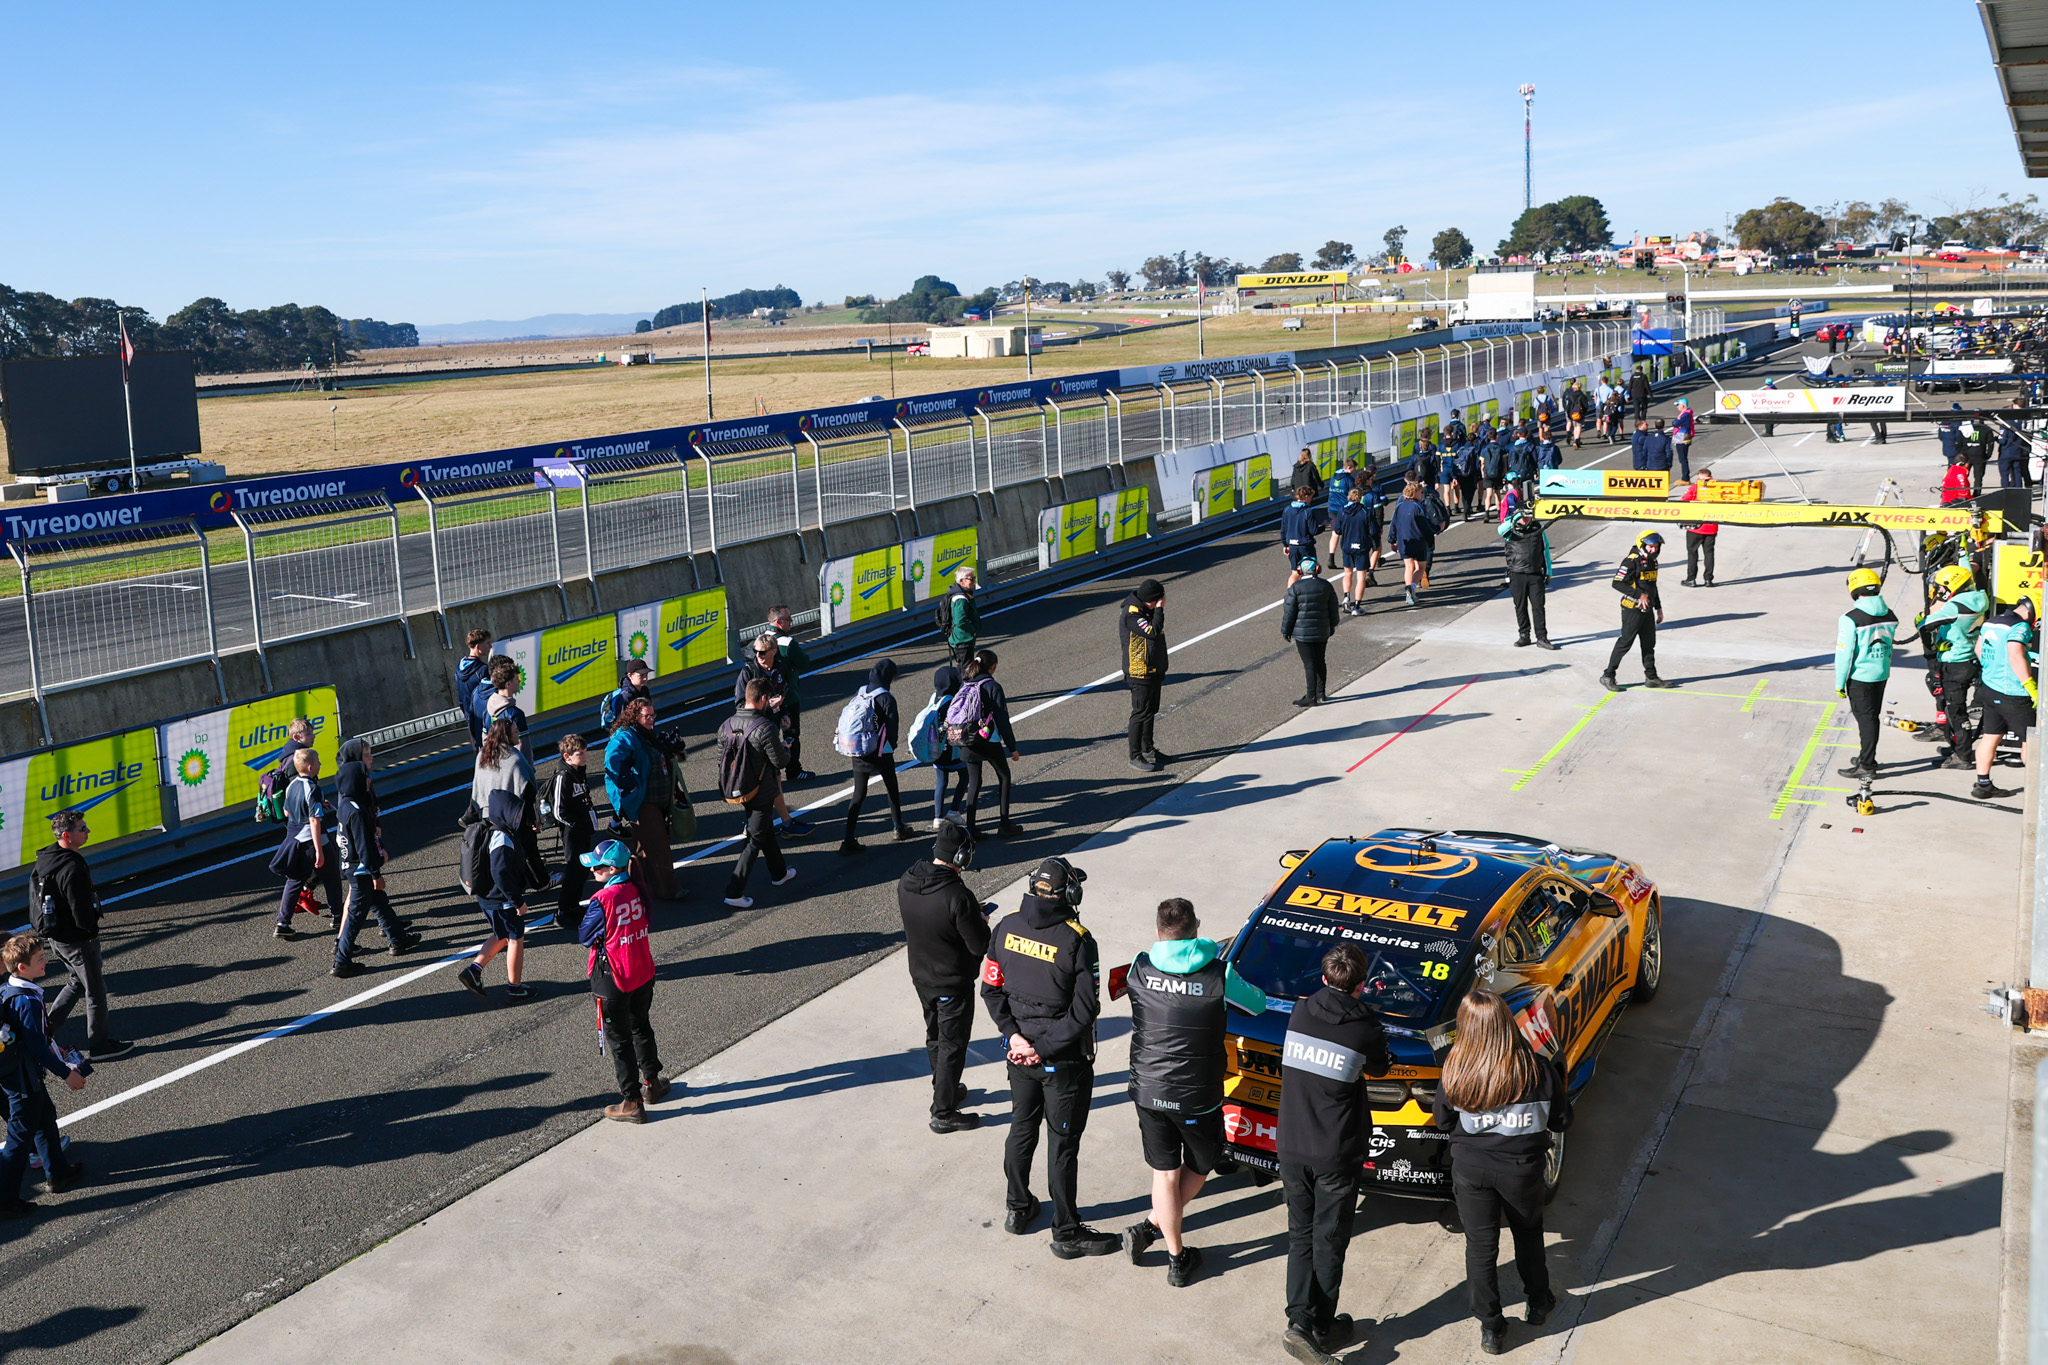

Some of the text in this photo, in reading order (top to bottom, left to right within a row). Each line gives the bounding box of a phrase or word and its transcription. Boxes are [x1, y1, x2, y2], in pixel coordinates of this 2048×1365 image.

[1264, 275, 1329, 285] DUNLOP
[1505, 323, 1524, 335] PLAINS
[1184, 359, 1235, 378] MOTORSPORTS
[1237, 356, 1270, 371] TASMANIA
[1059, 377, 1099, 394] Tyrepower
[987, 386, 1032, 404] Tyrepower
[1847, 394, 1894, 406] Repco
[906, 397, 957, 415] Tyrepower
[811, 409, 869, 428] Tyrepower
[702, 421, 770, 444] Tyrepower
[571, 438, 651, 460] Tyrepower
[420, 457, 513, 483] Tyrepower
[234, 478, 347, 509] Tyrepower
[1118, 498, 1145, 514] ultimate
[1545, 504, 1586, 516] JAX
[1586, 506, 1631, 515] TYRES
[1642, 508, 1681, 517] AUTO
[6, 505, 143, 539] Tyrepower
[1064, 513, 1093, 530] ultimate
[1822, 511, 1871, 523] JAX
[1872, 514, 1926, 523] TYRES
[1940, 516, 1974, 525] AUT
[936, 544, 972, 563] ultimate
[857, 564, 897, 585] ultimate
[639, 618, 649, 629] bp
[666, 608, 719, 634] ultimate
[516, 650, 527, 661] bp
[547, 637, 608, 666] ultimate
[194, 731, 209, 745] bp
[239, 714, 326, 750] ultime
[40, 761, 143, 801] ultimate
[620, 933, 634, 946] PIT
[1262, 915, 1420, 950] Industrial Batteries
[1537, 922, 1551, 948] 18
[987, 966, 999, 981] 3
[1419, 960, 1450, 981] 18
[1475, 959, 1495, 978] FUCHS
[1286, 1040, 1346, 1072] TRADIE
[1388, 1069, 1418, 1077] EIKO
[1152, 1098, 1181, 1111] TRADIE
[1470, 1111, 1533, 1130] TRADIE
[1368, 1138, 1396, 1148] CHS
[1405, 1128, 1450, 1140] Taubmans
[1233, 1151, 1273, 1169] WAVERLEY
[1376, 1175, 1445, 1185] SPECIALIST
[1377, 1168, 1444, 1180] TREE CLEANUP
